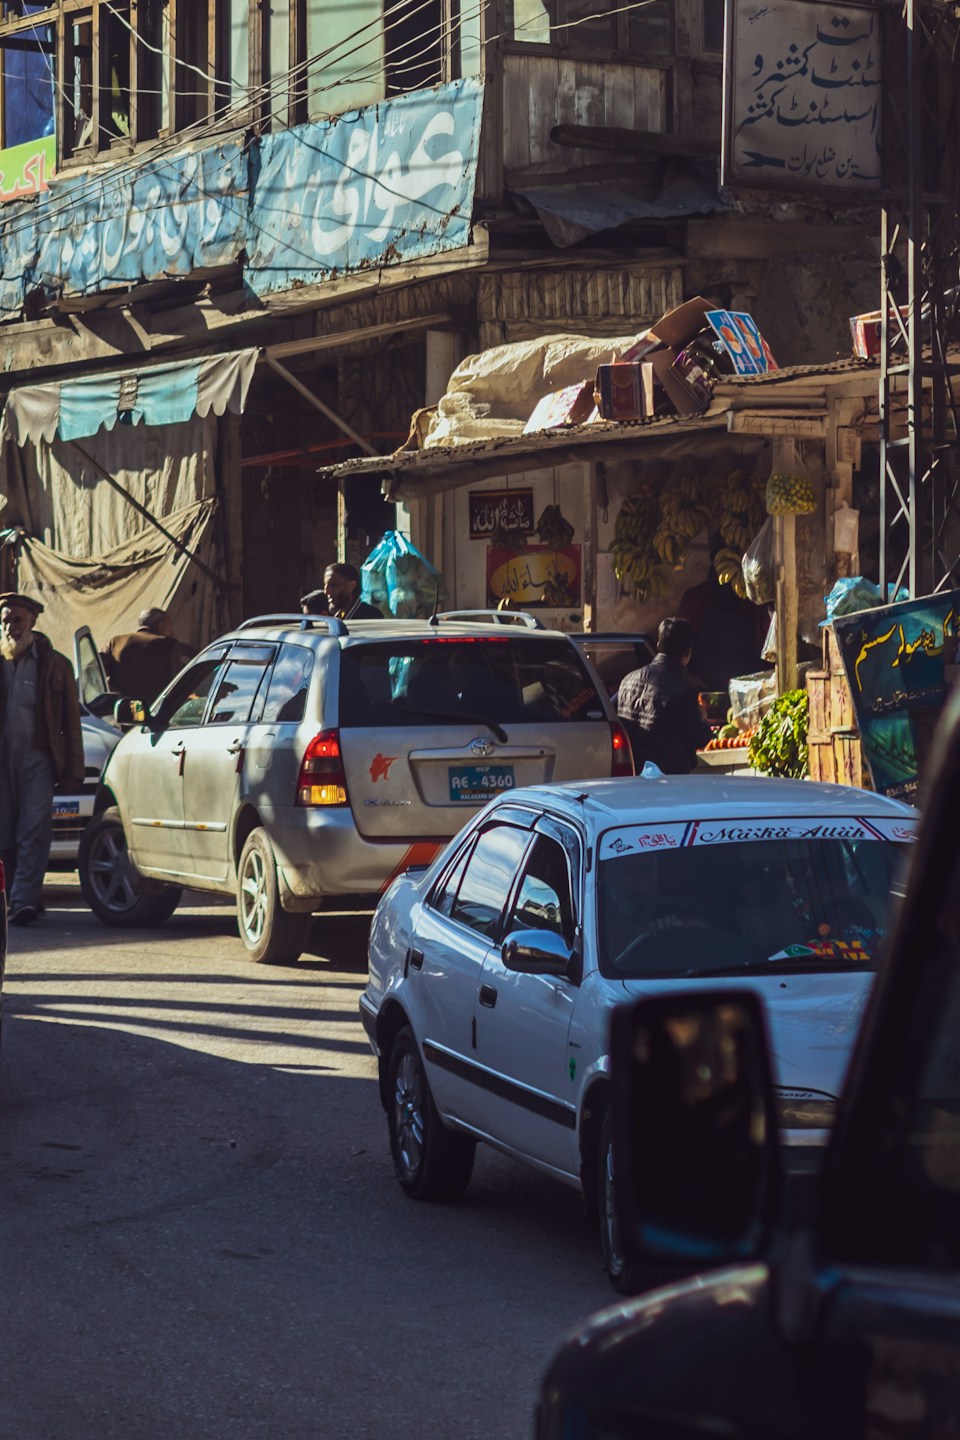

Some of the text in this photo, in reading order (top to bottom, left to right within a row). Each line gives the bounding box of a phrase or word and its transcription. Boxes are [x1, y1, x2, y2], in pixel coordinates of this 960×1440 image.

[754, 41, 818, 92] کمشنر
[734, 85, 879, 137] اسسٹنٹ کمشنر
[789, 141, 818, 176] سوات
[815, 141, 836, 177] ضلع
[311, 112, 464, 255] عوامی
[480, 775, 513, 788] 4360
